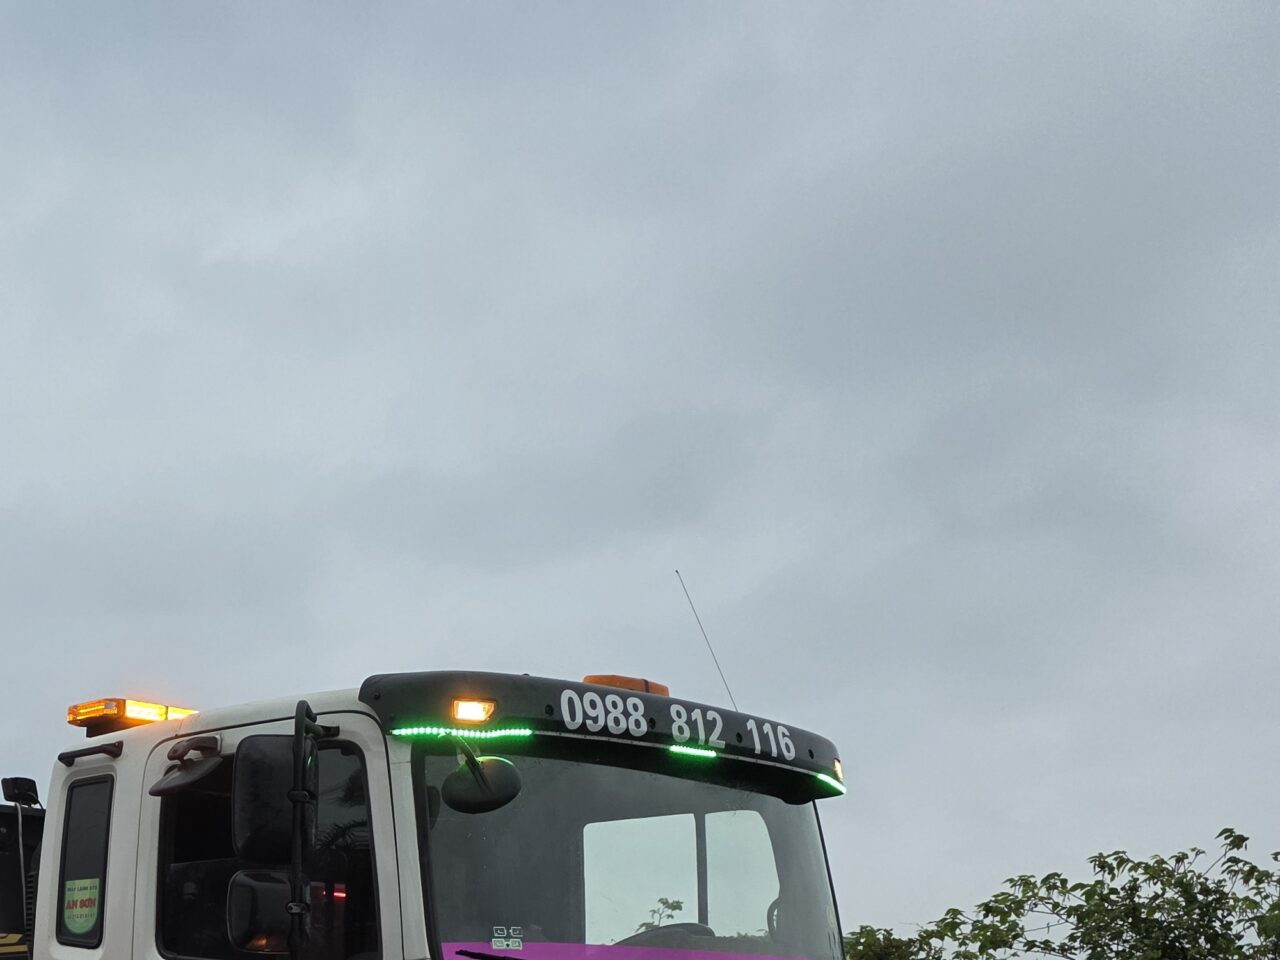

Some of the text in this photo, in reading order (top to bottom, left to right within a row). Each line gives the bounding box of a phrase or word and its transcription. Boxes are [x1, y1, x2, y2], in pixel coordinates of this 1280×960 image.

[561, 689, 796, 761] 0988 812 116
